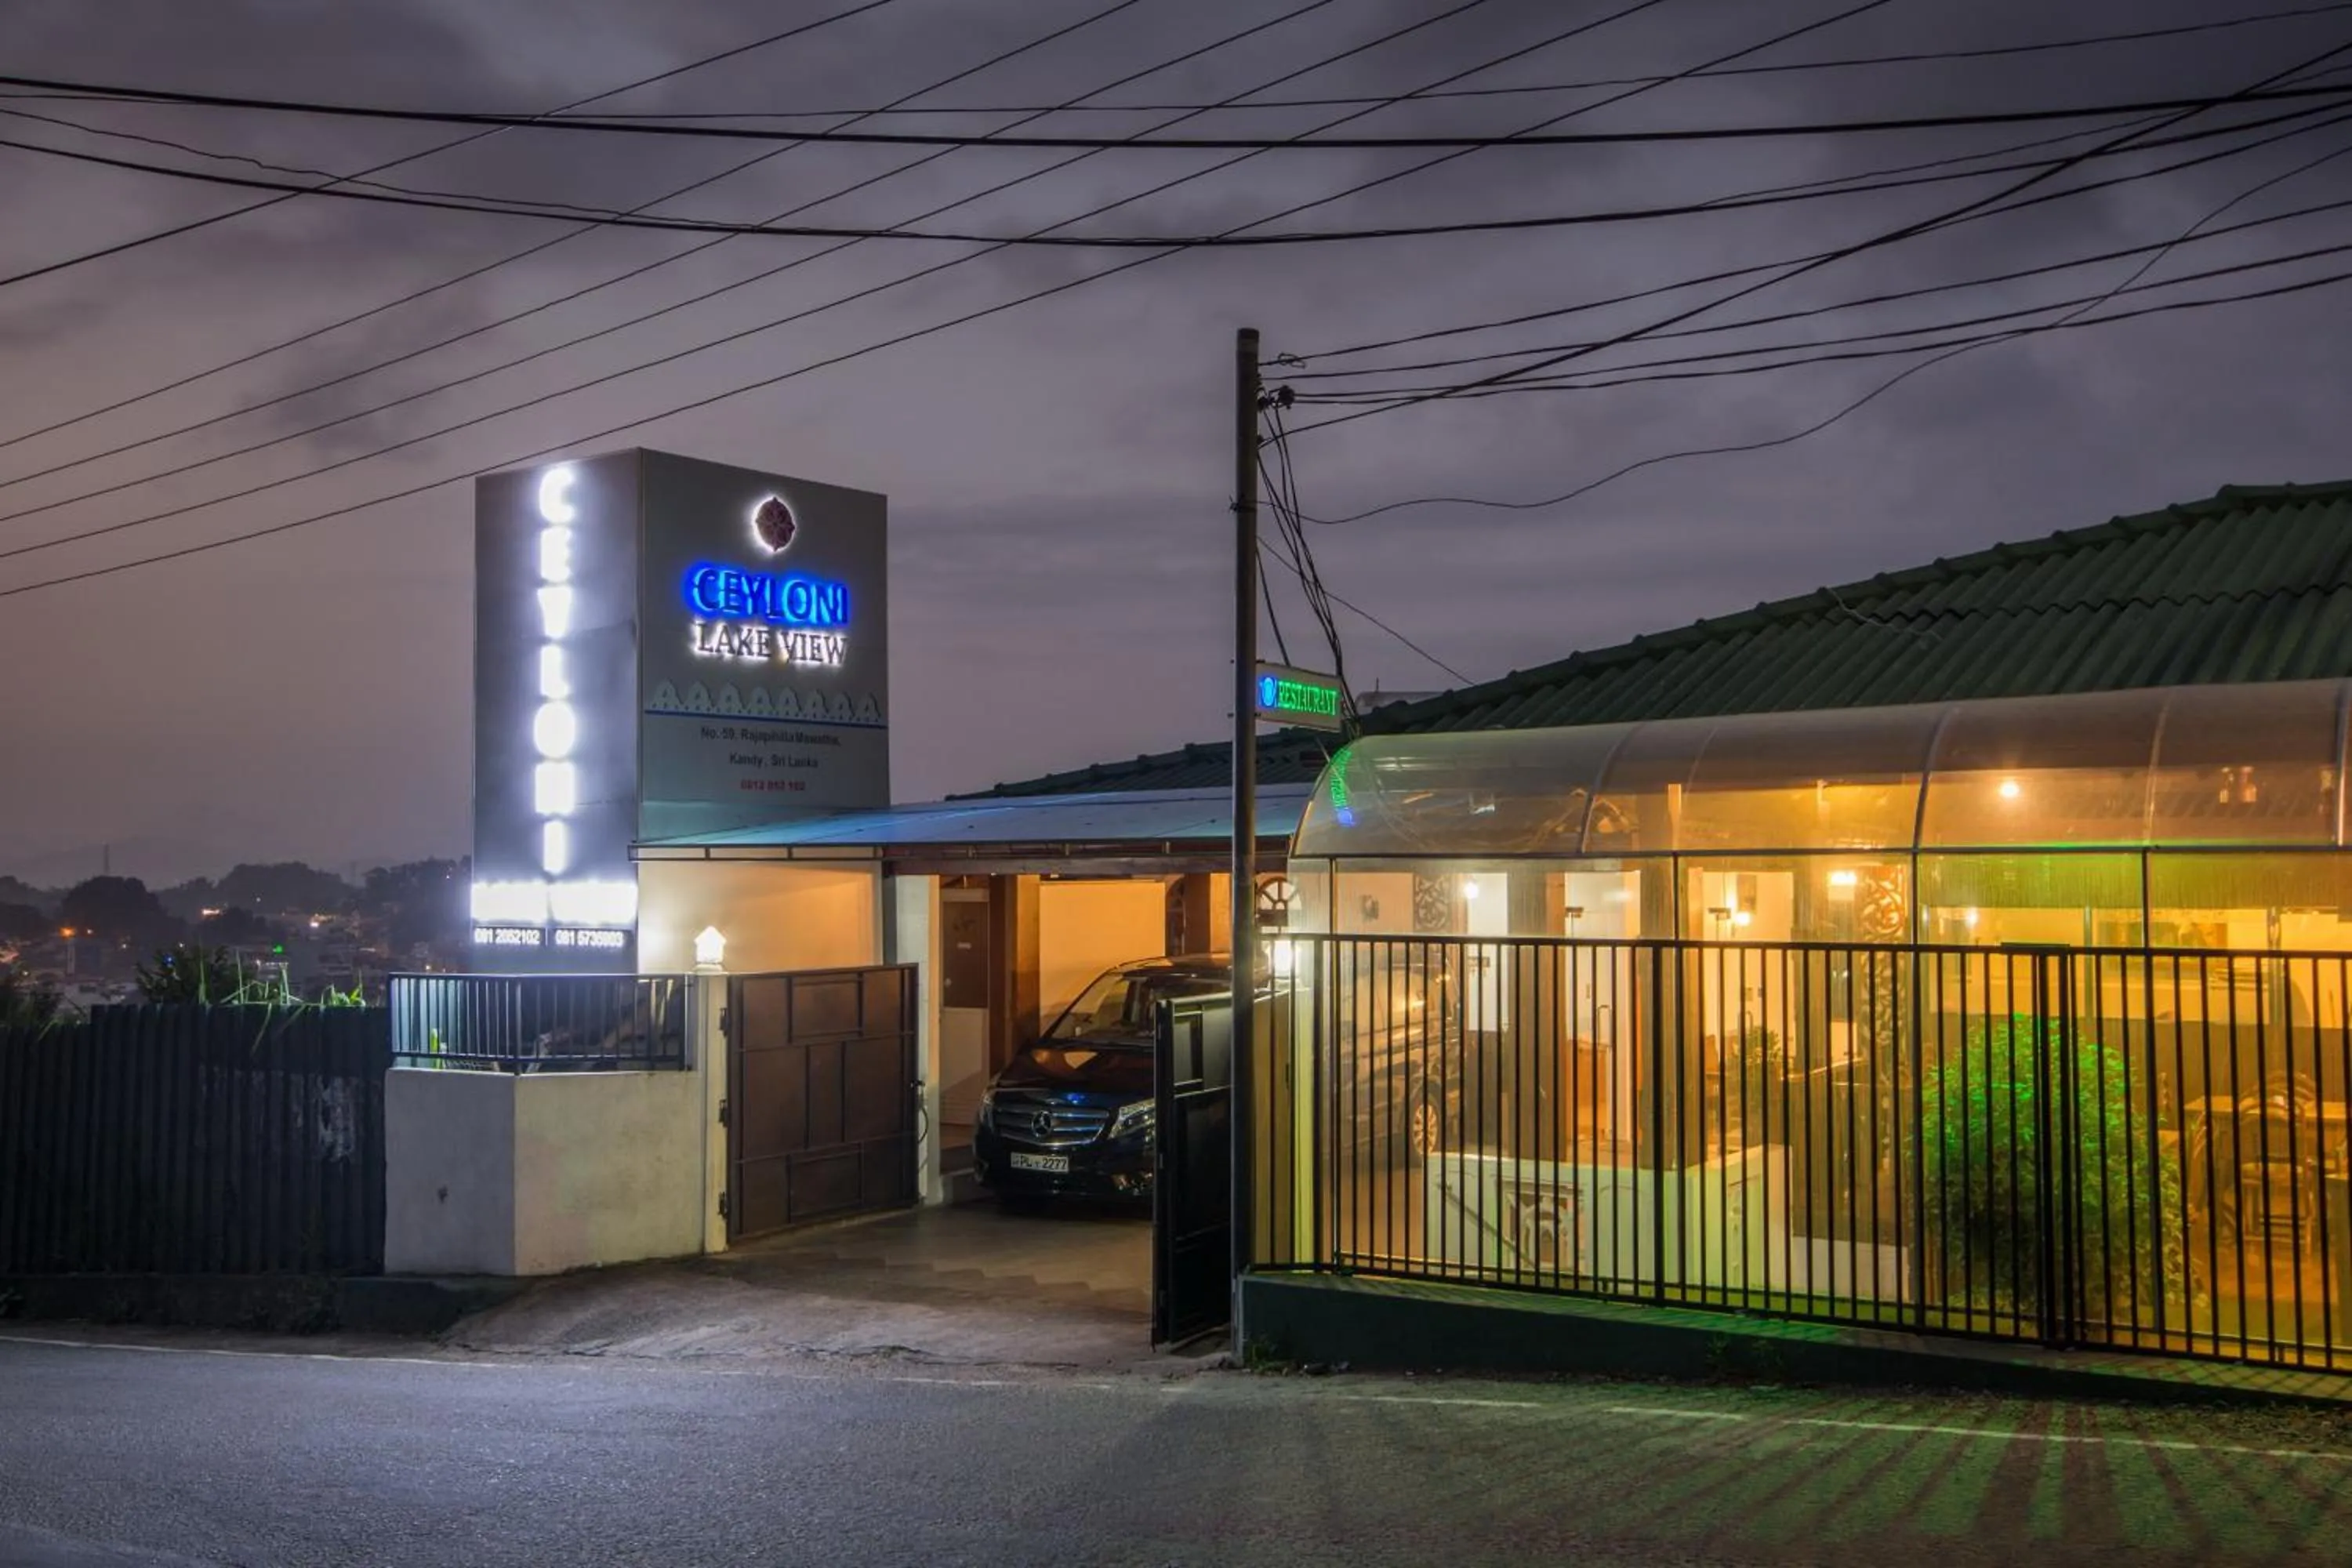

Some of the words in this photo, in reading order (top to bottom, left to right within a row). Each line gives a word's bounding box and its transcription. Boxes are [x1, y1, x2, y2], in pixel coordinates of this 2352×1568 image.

[693, 567, 848, 624] CEYLONI
[695, 622, 772, 659] LAKE
[780, 630, 849, 665] VIEW
[771, 753, 785, 767] Sri
[788, 754, 818, 768] Lanka
